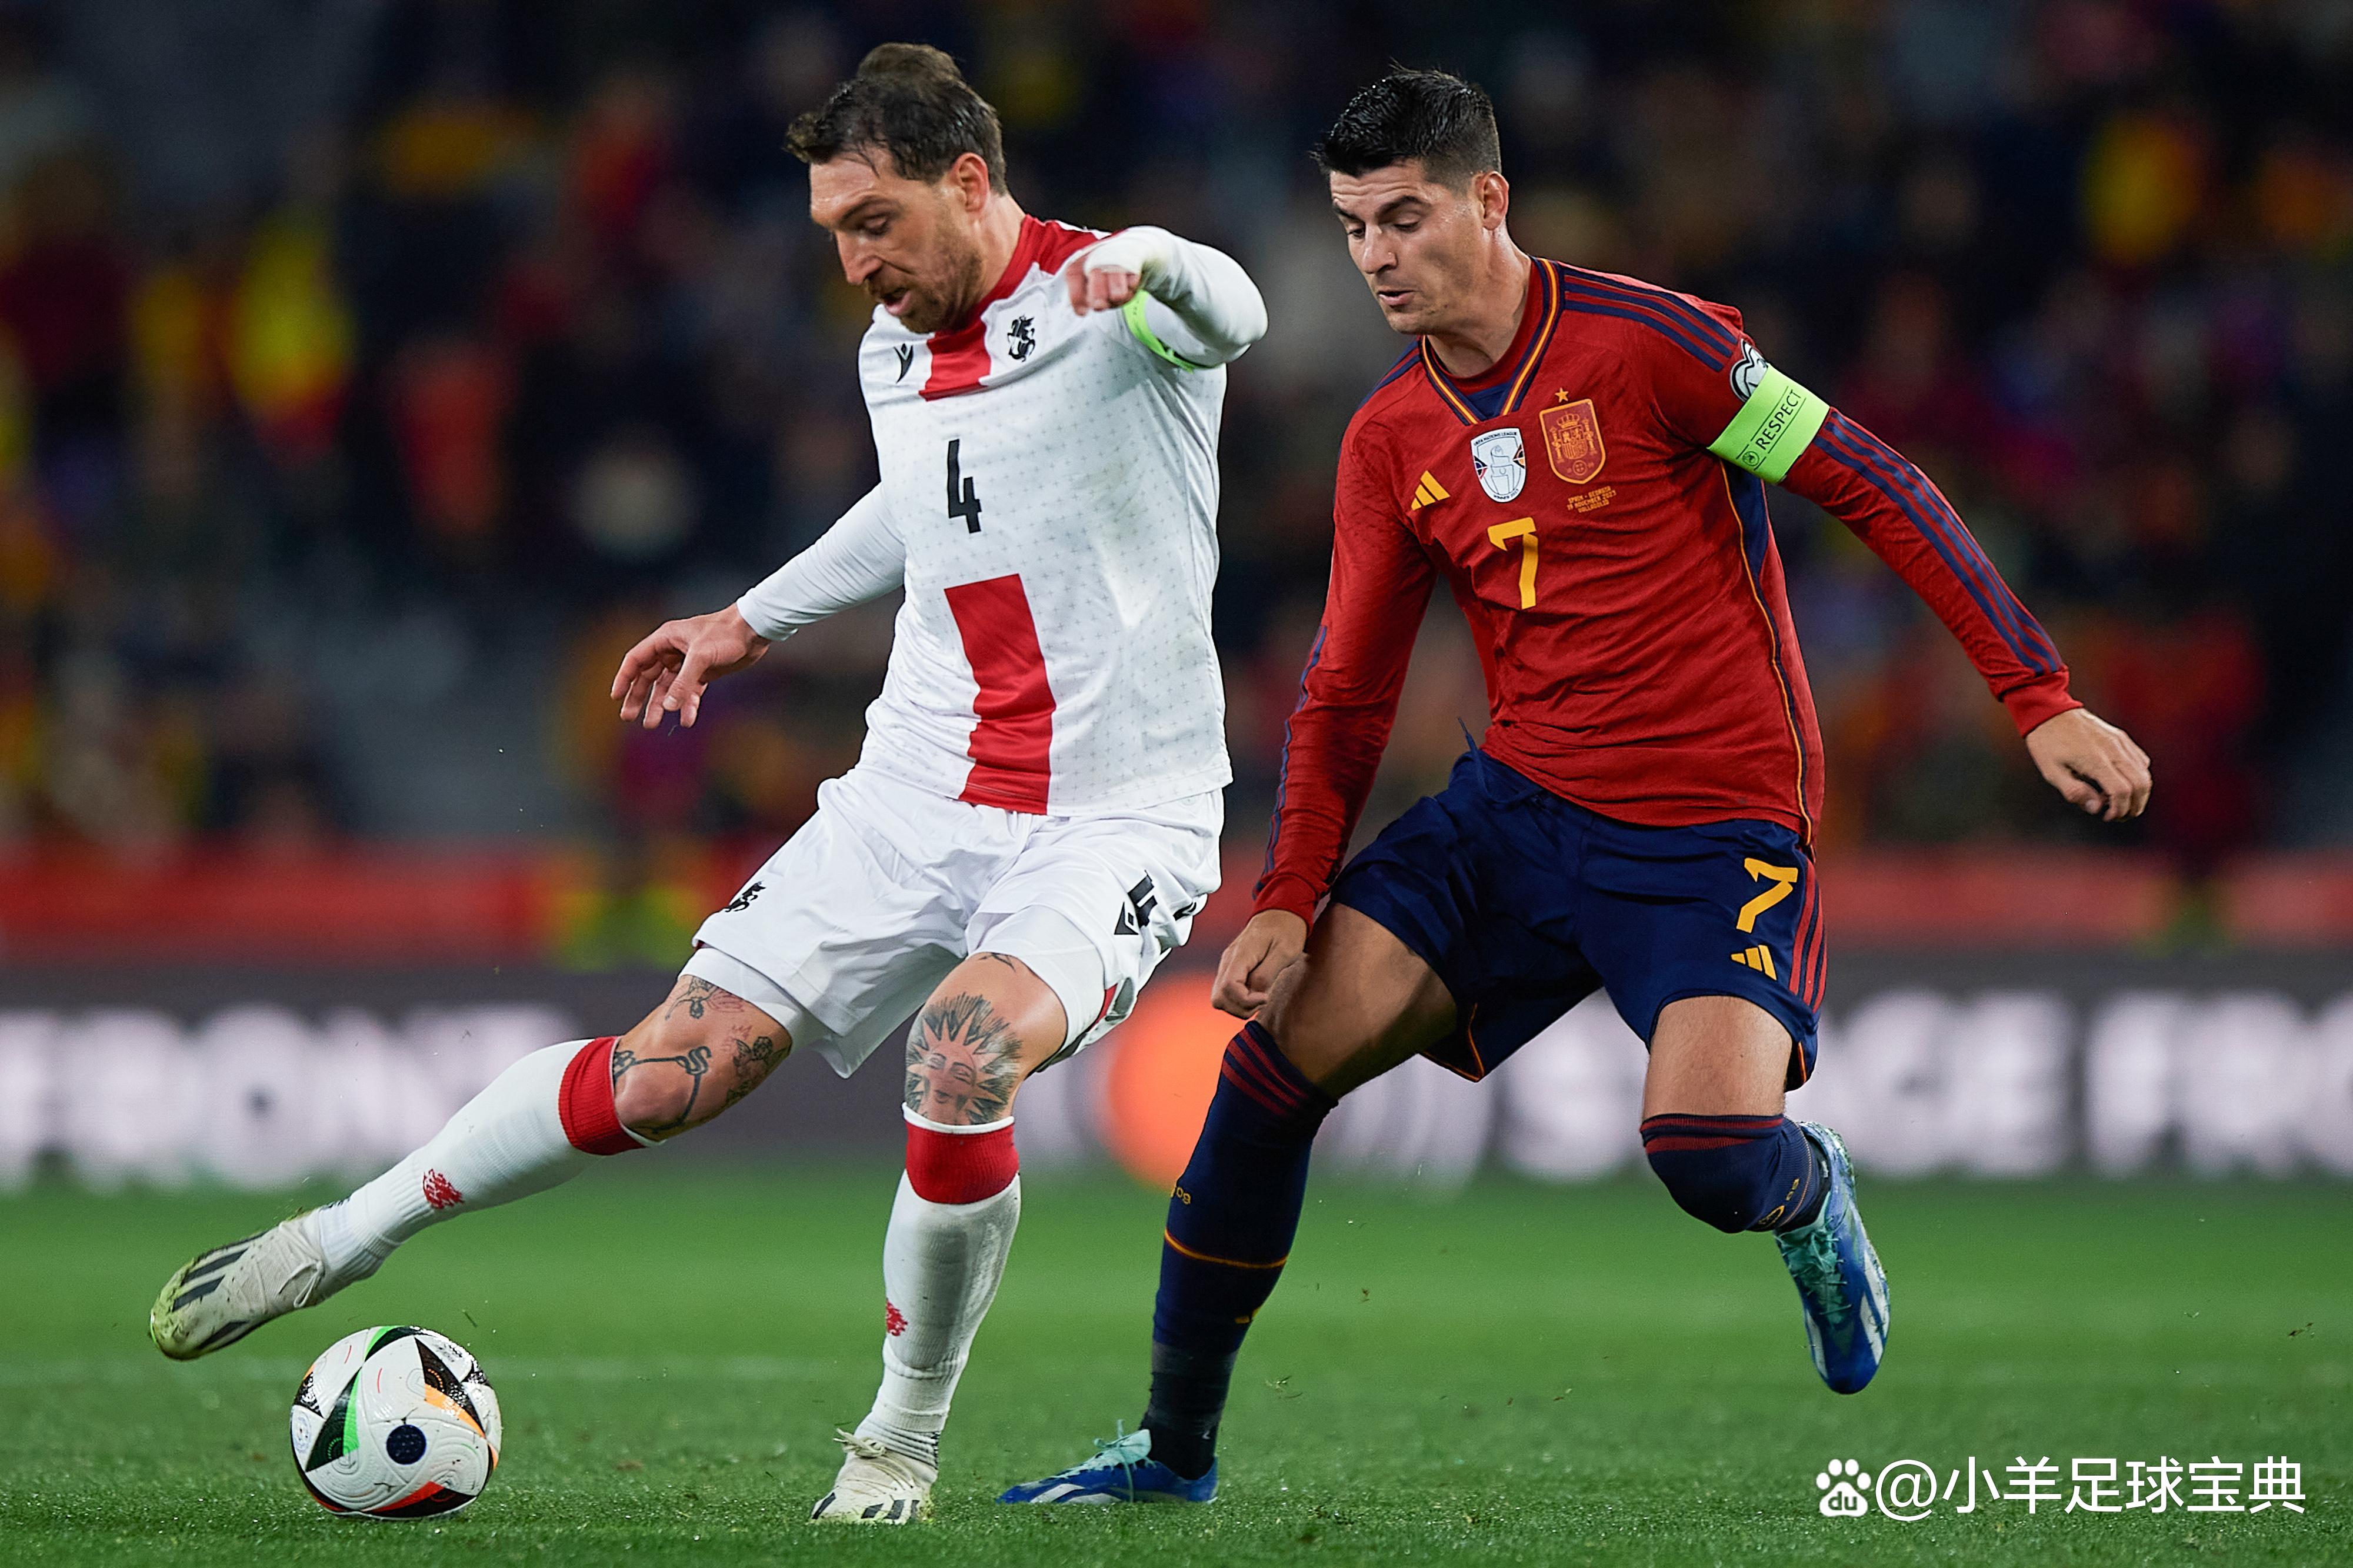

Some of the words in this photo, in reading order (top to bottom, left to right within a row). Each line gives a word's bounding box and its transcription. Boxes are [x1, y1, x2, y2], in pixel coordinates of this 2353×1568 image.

[1755, 389, 1801, 450] RESPECT
[948, 439, 982, 533] 4
[1487, 517, 1539, 610] 7
[1736, 858, 1798, 933] 7
